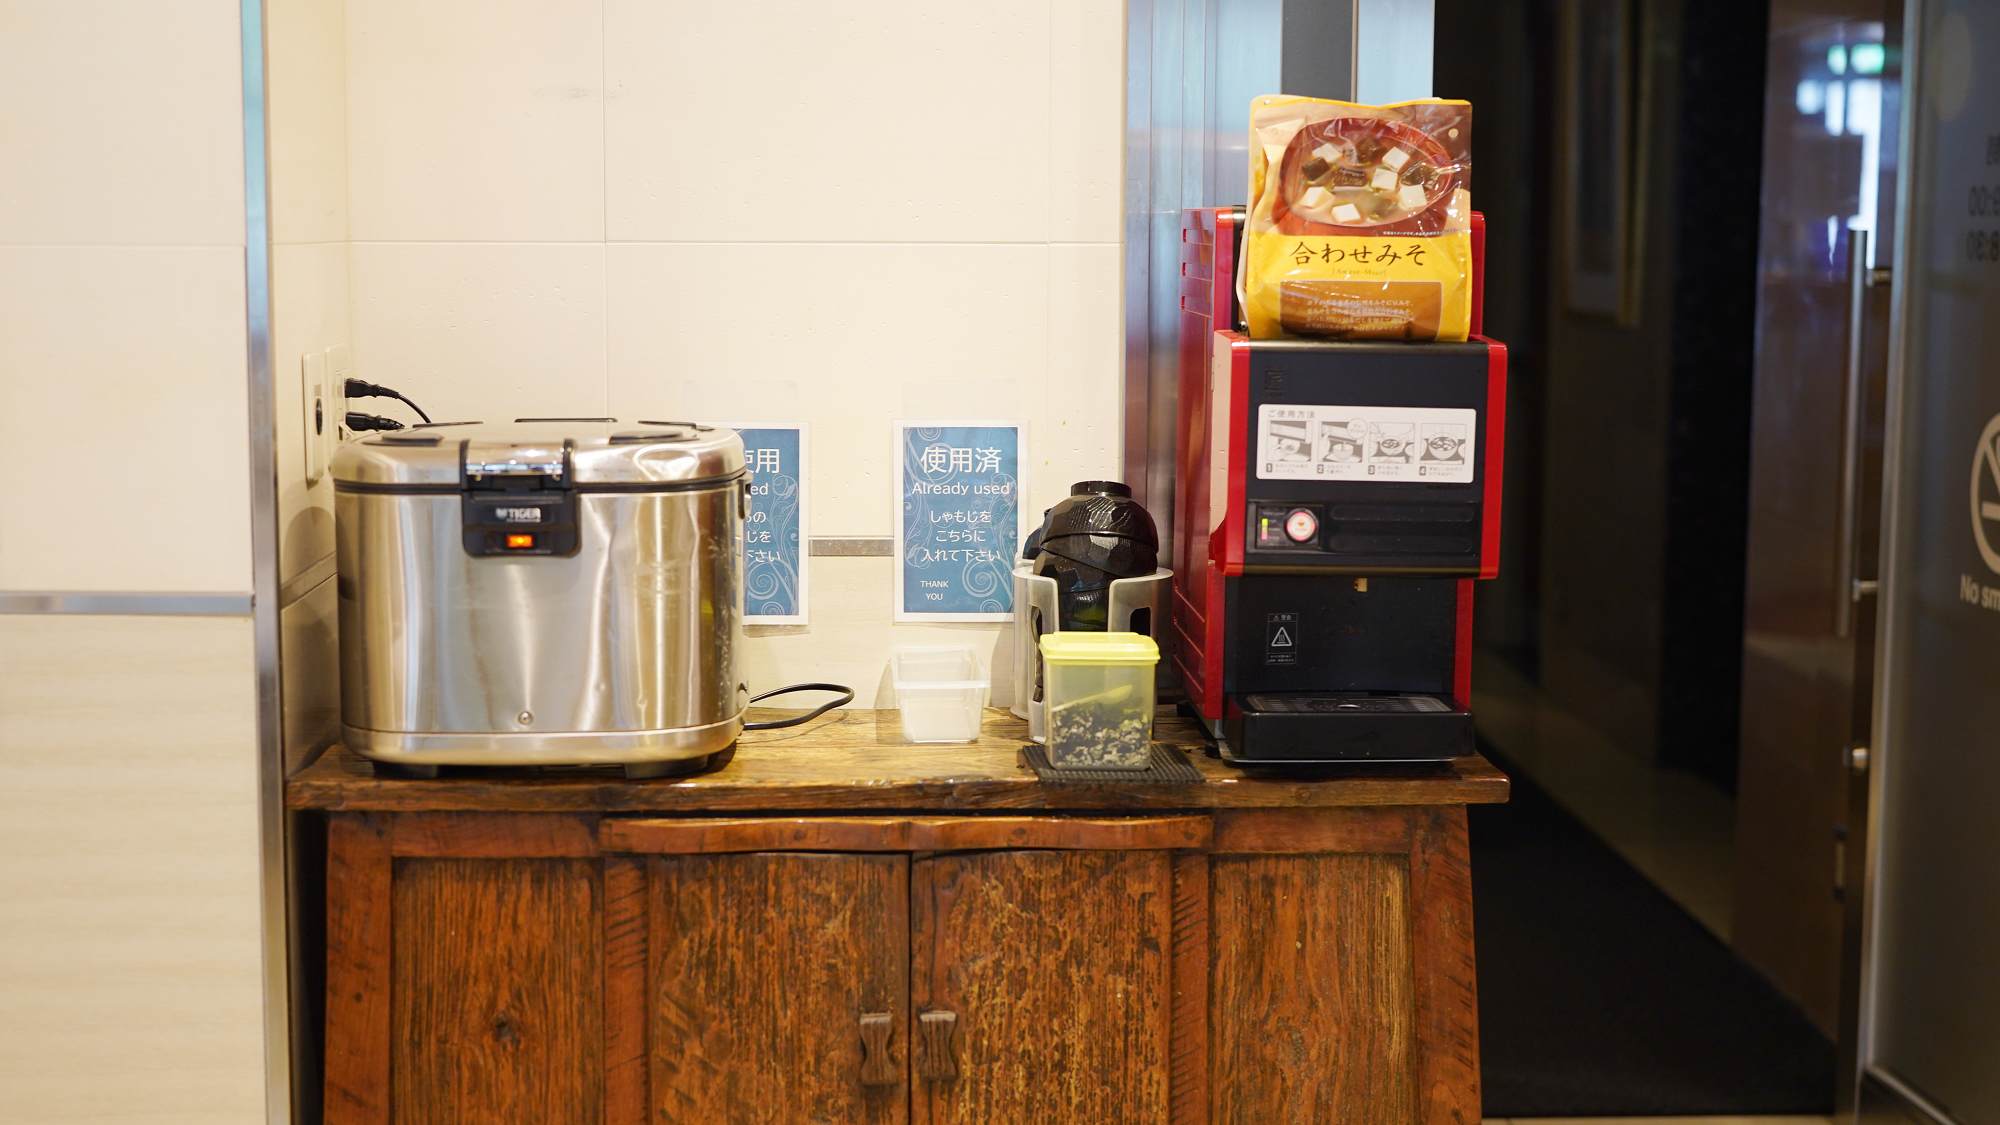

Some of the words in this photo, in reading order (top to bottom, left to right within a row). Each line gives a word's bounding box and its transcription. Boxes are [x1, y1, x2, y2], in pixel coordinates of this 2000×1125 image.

[1289, 242, 1426, 266] 合わせみそ
[921, 447, 1002, 474] 使用済
[911, 482, 969, 496] Already
[974, 482, 1010, 495] used
[508, 507, 541, 519] TIGER
[930, 510, 991, 523] しゃもじを
[935, 529, 985, 542] こちらに
[921, 549, 1001, 562] 入れて下さい
[920, 580, 949, 588] THANK
[1960, 573, 1979, 604] No
[926, 593, 943, 601] YOU
